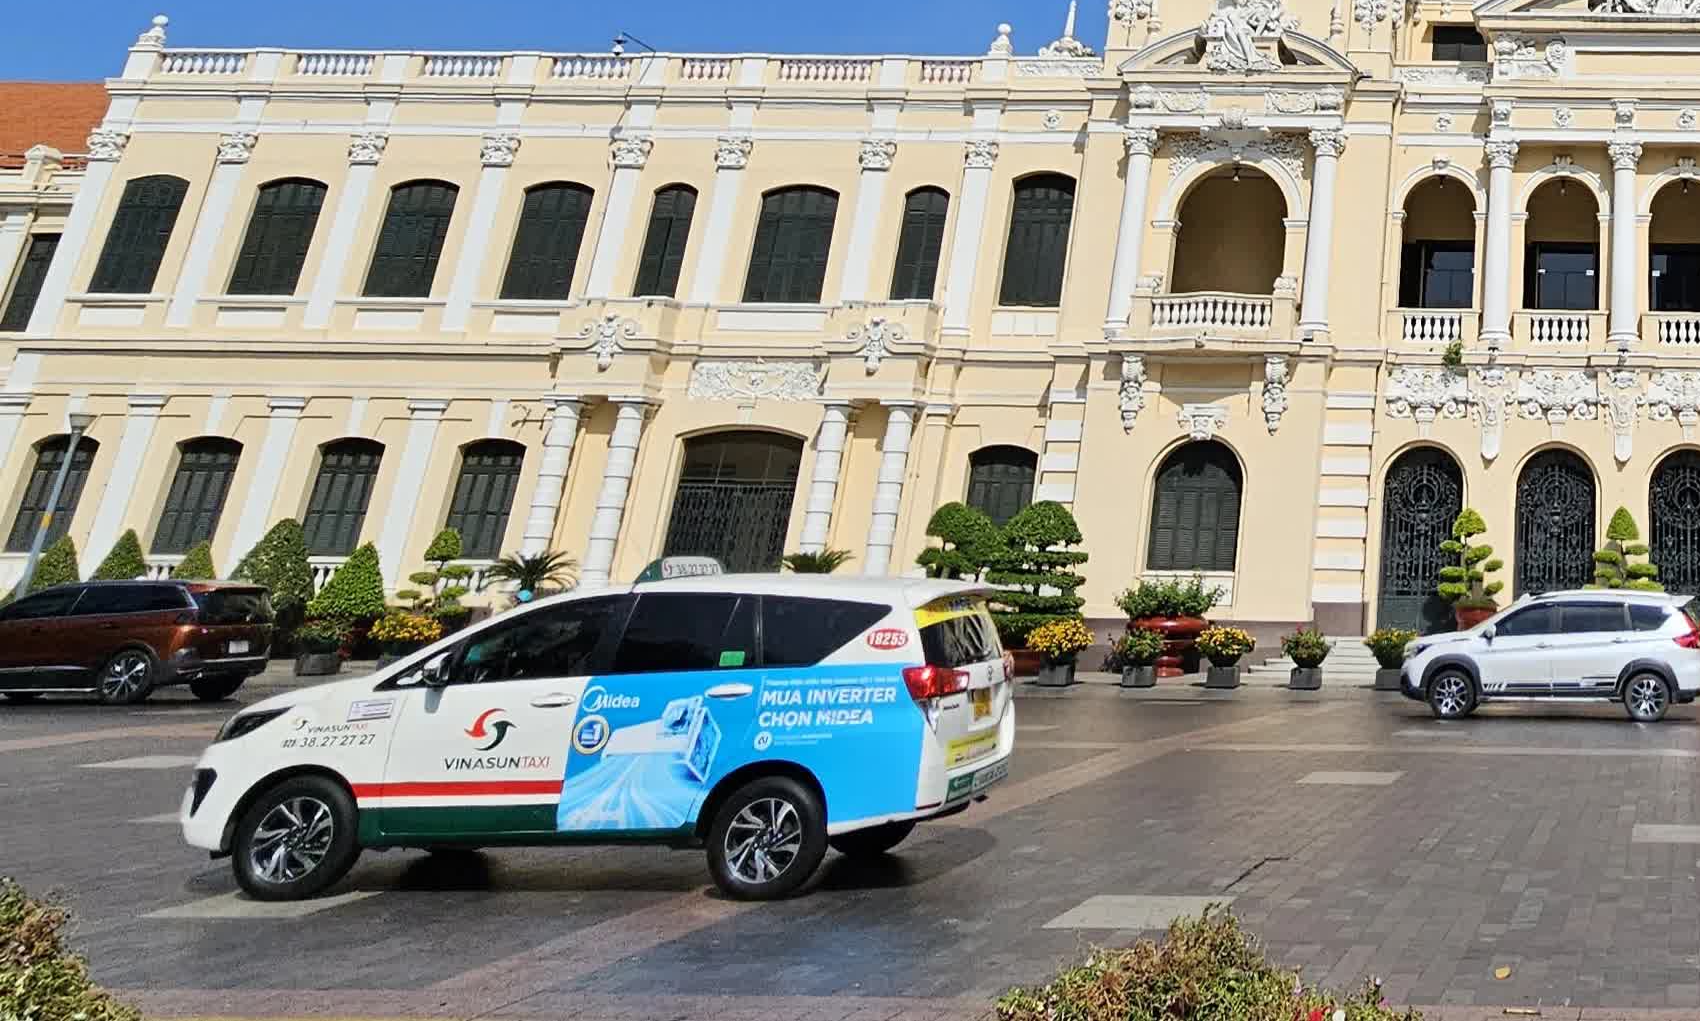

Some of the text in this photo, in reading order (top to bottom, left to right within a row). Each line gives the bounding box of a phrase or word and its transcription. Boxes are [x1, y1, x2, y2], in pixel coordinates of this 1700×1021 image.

[762, 686, 897, 706] MUA INVERTER
[759, 708, 874, 730] CHỌN MIDEA
